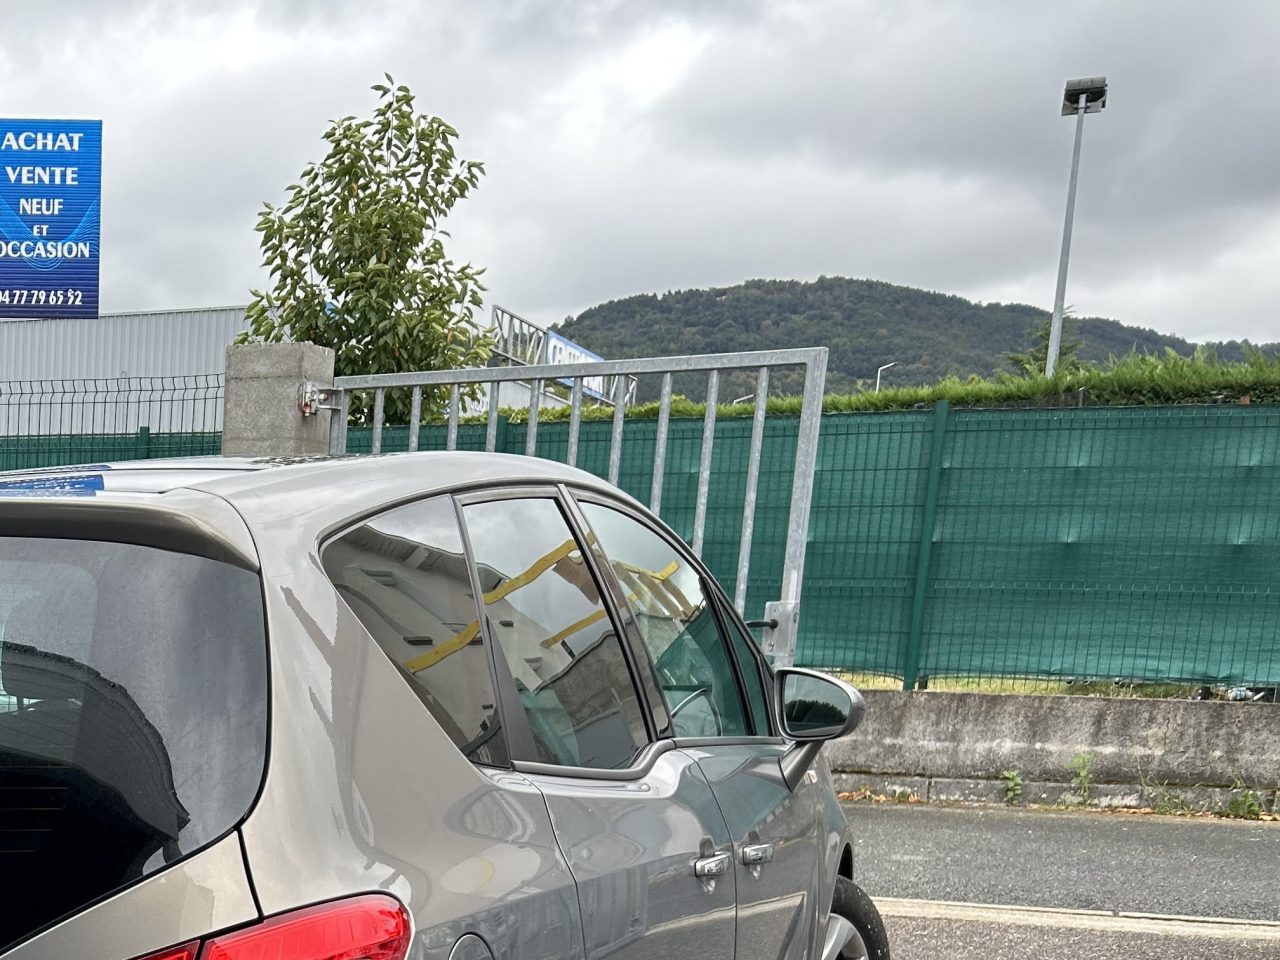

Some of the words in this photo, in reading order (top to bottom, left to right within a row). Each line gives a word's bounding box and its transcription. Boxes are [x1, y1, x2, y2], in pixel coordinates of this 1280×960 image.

[0, 131, 84, 152] ACHAT
[5, 166, 78, 186] VENTE
[19, 197, 64, 216] NEUF
[32, 224, 49, 237] ET
[12, 290, 28, 304] 77
[30, 290, 46, 305] 79
[48, 290, 64, 305] 65
